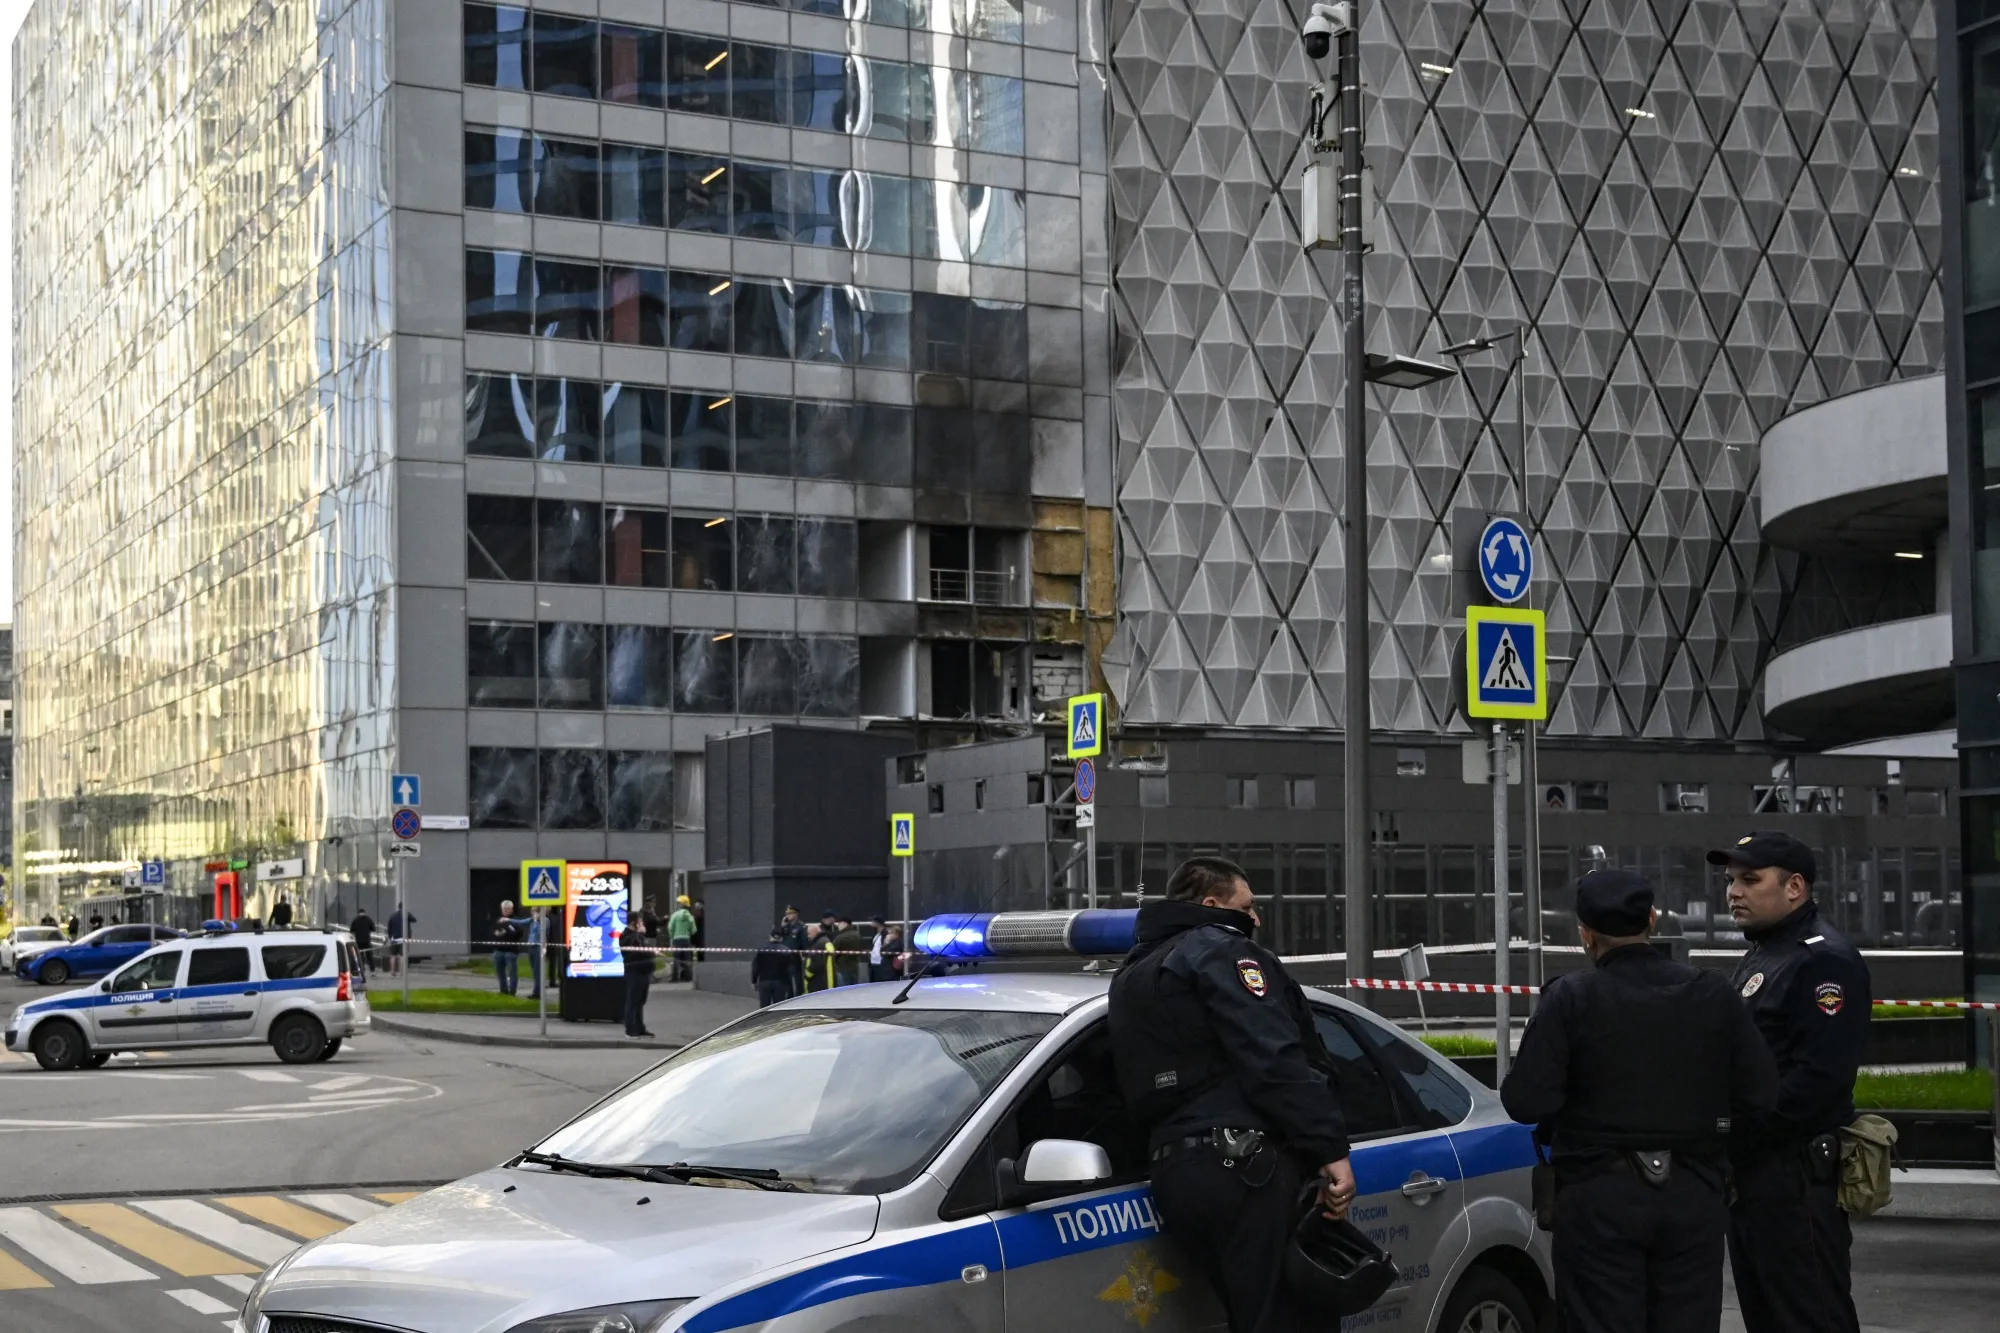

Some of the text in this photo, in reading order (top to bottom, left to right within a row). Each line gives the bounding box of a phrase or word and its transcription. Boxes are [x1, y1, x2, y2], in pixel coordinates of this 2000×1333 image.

[570, 877, 624, 891] 730-23-33
[110, 992, 155, 1003] ПОЛИЦИЯ
[1352, 1204, 1388, 1222] России
[1389, 1224, 1410, 1243] р-ну
[1376, 1305, 1402, 1322] части
